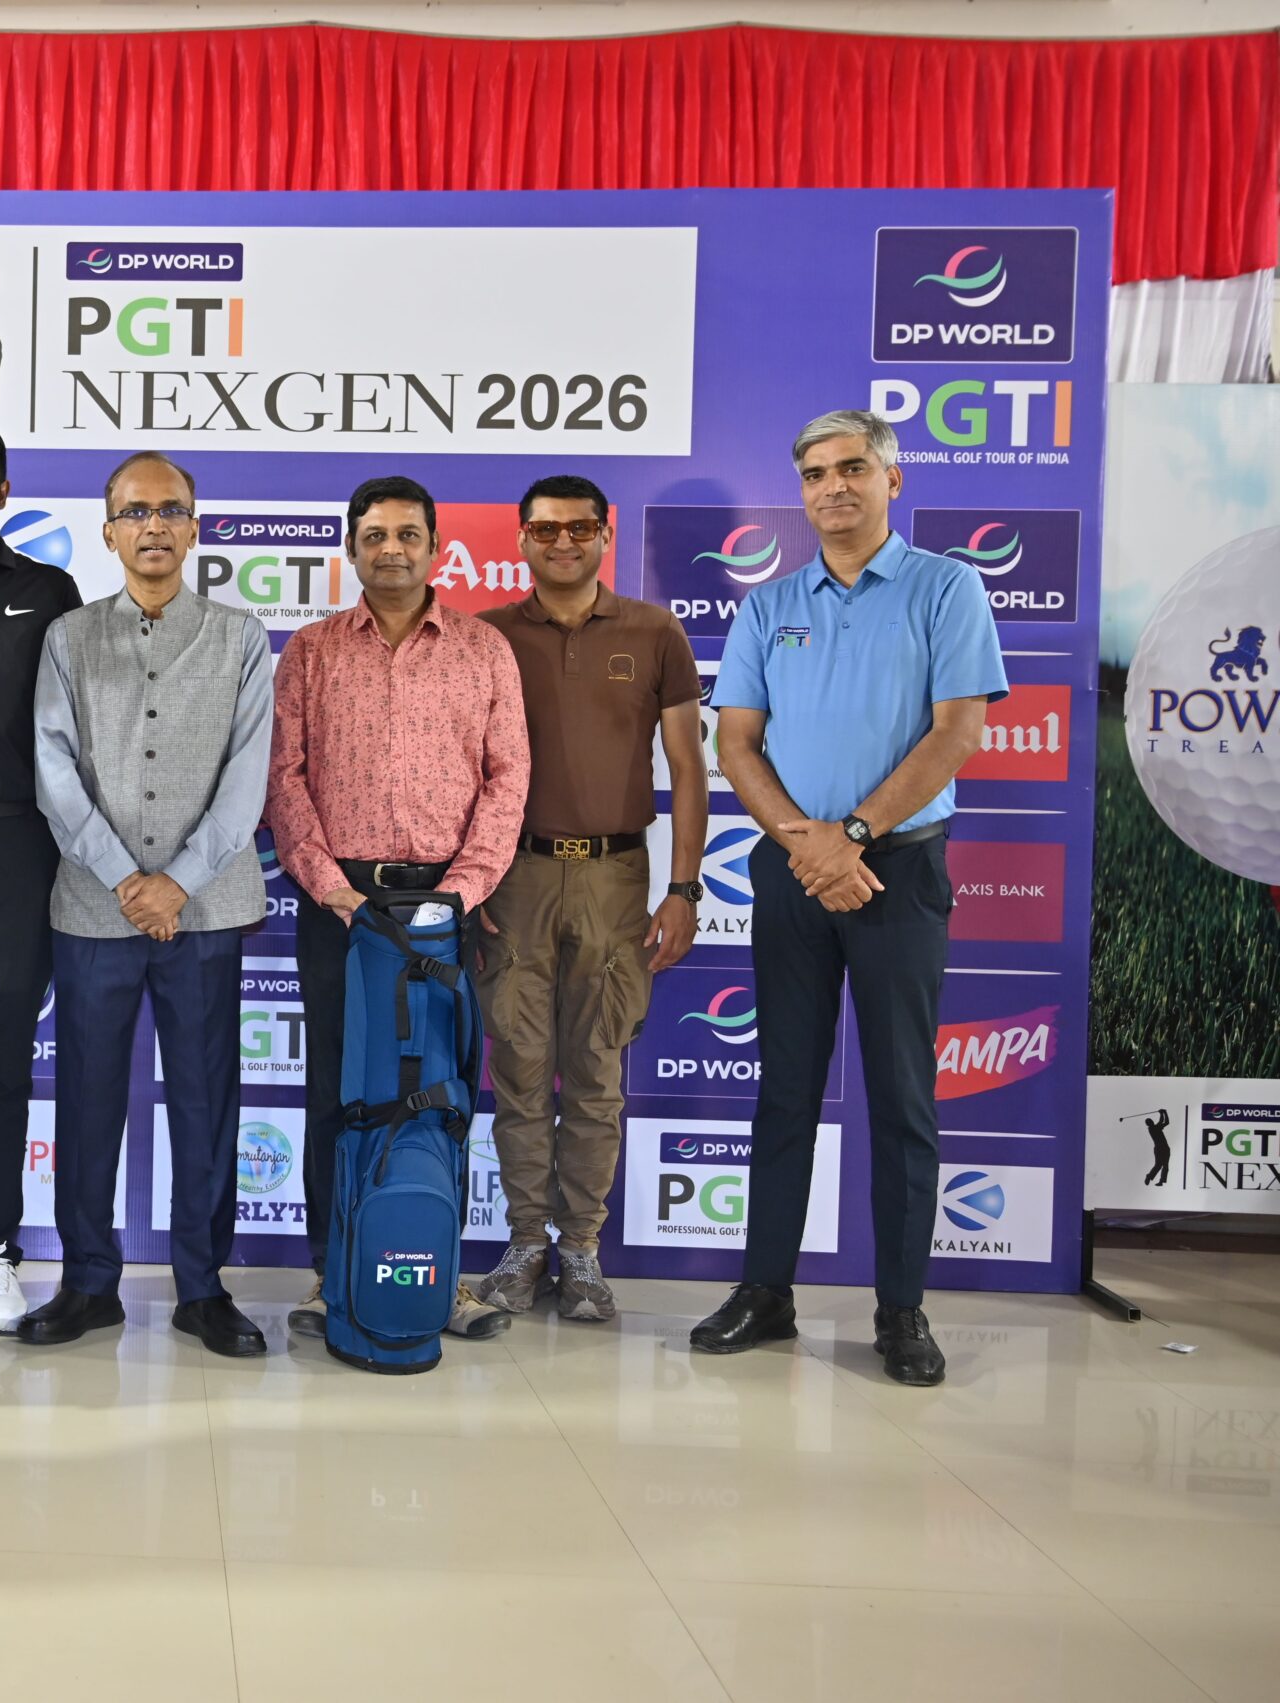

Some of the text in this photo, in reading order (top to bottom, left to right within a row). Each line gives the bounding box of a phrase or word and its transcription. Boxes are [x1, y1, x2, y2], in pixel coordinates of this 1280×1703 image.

[117, 252, 235, 271] DP WORLD
[66, 295, 244, 358] PGTI
[891, 324, 1056, 346] DP WORLD
[61, 369, 649, 434] NEXGEN 2026
[869, 379, 1073, 448] PGTI
[896, 451, 1070, 465] ESSIONAL GOLF TOUR OF INDIA
[240, 523, 335, 538] DP WORLD
[431, 540, 534, 593] Am
[196, 555, 342, 605] PGTI
[257, 608, 277, 617] GOLF
[280, 608, 301, 618] TOUR
[304, 609, 314, 618] OF
[670, 599, 709, 619] DP
[1148, 688, 1280, 734] POW
[980, 711, 1061, 754] mul
[1147, 739, 1264, 754] TREA
[957, 883, 1046, 898] AXIS BANK
[697, 917, 748, 933] KALY
[258, 980, 300, 993] WOR
[240, 1010, 305, 1060] GT
[934, 1023, 1050, 1076] AMPA
[247, 1062, 268, 1071] GOLF
[270, 1063, 292, 1072] TOUR
[294, 1063, 304, 1072] OF
[657, 1058, 697, 1079] DP
[1226, 1109, 1280, 1118] DP WORLD
[703, 1143, 728, 1156] DP
[1201, 1128, 1280, 1157] PGT
[237, 1145, 290, 1174] mrutanjan
[472, 1170, 500, 1203] LF
[1199, 1161, 1280, 1191] NEX
[657, 1172, 744, 1224] PG
[657, 1224, 717, 1236] PROFESSIONAL
[719, 1226, 741, 1236] GOLF
[933, 1239, 1012, 1254] KALYANI
[376, 1264, 435, 1286] PGTI
